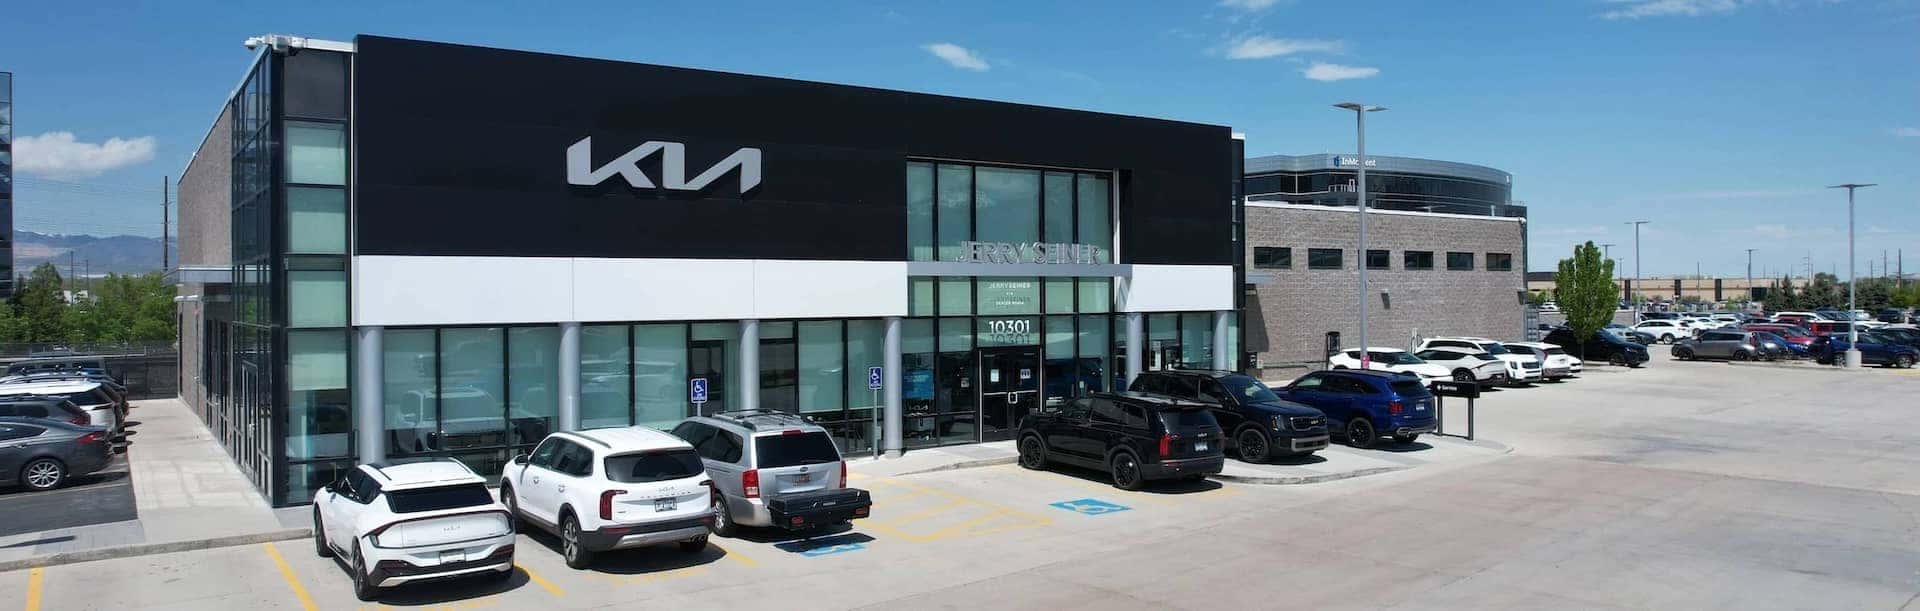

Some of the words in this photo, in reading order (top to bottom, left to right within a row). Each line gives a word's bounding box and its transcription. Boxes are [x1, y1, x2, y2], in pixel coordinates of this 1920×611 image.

[1342, 157, 1377, 167] InMoent
[957, 240, 1027, 264] JERRY
[1033, 241, 1101, 266] SEINER
[989, 319, 1030, 334] 10301
